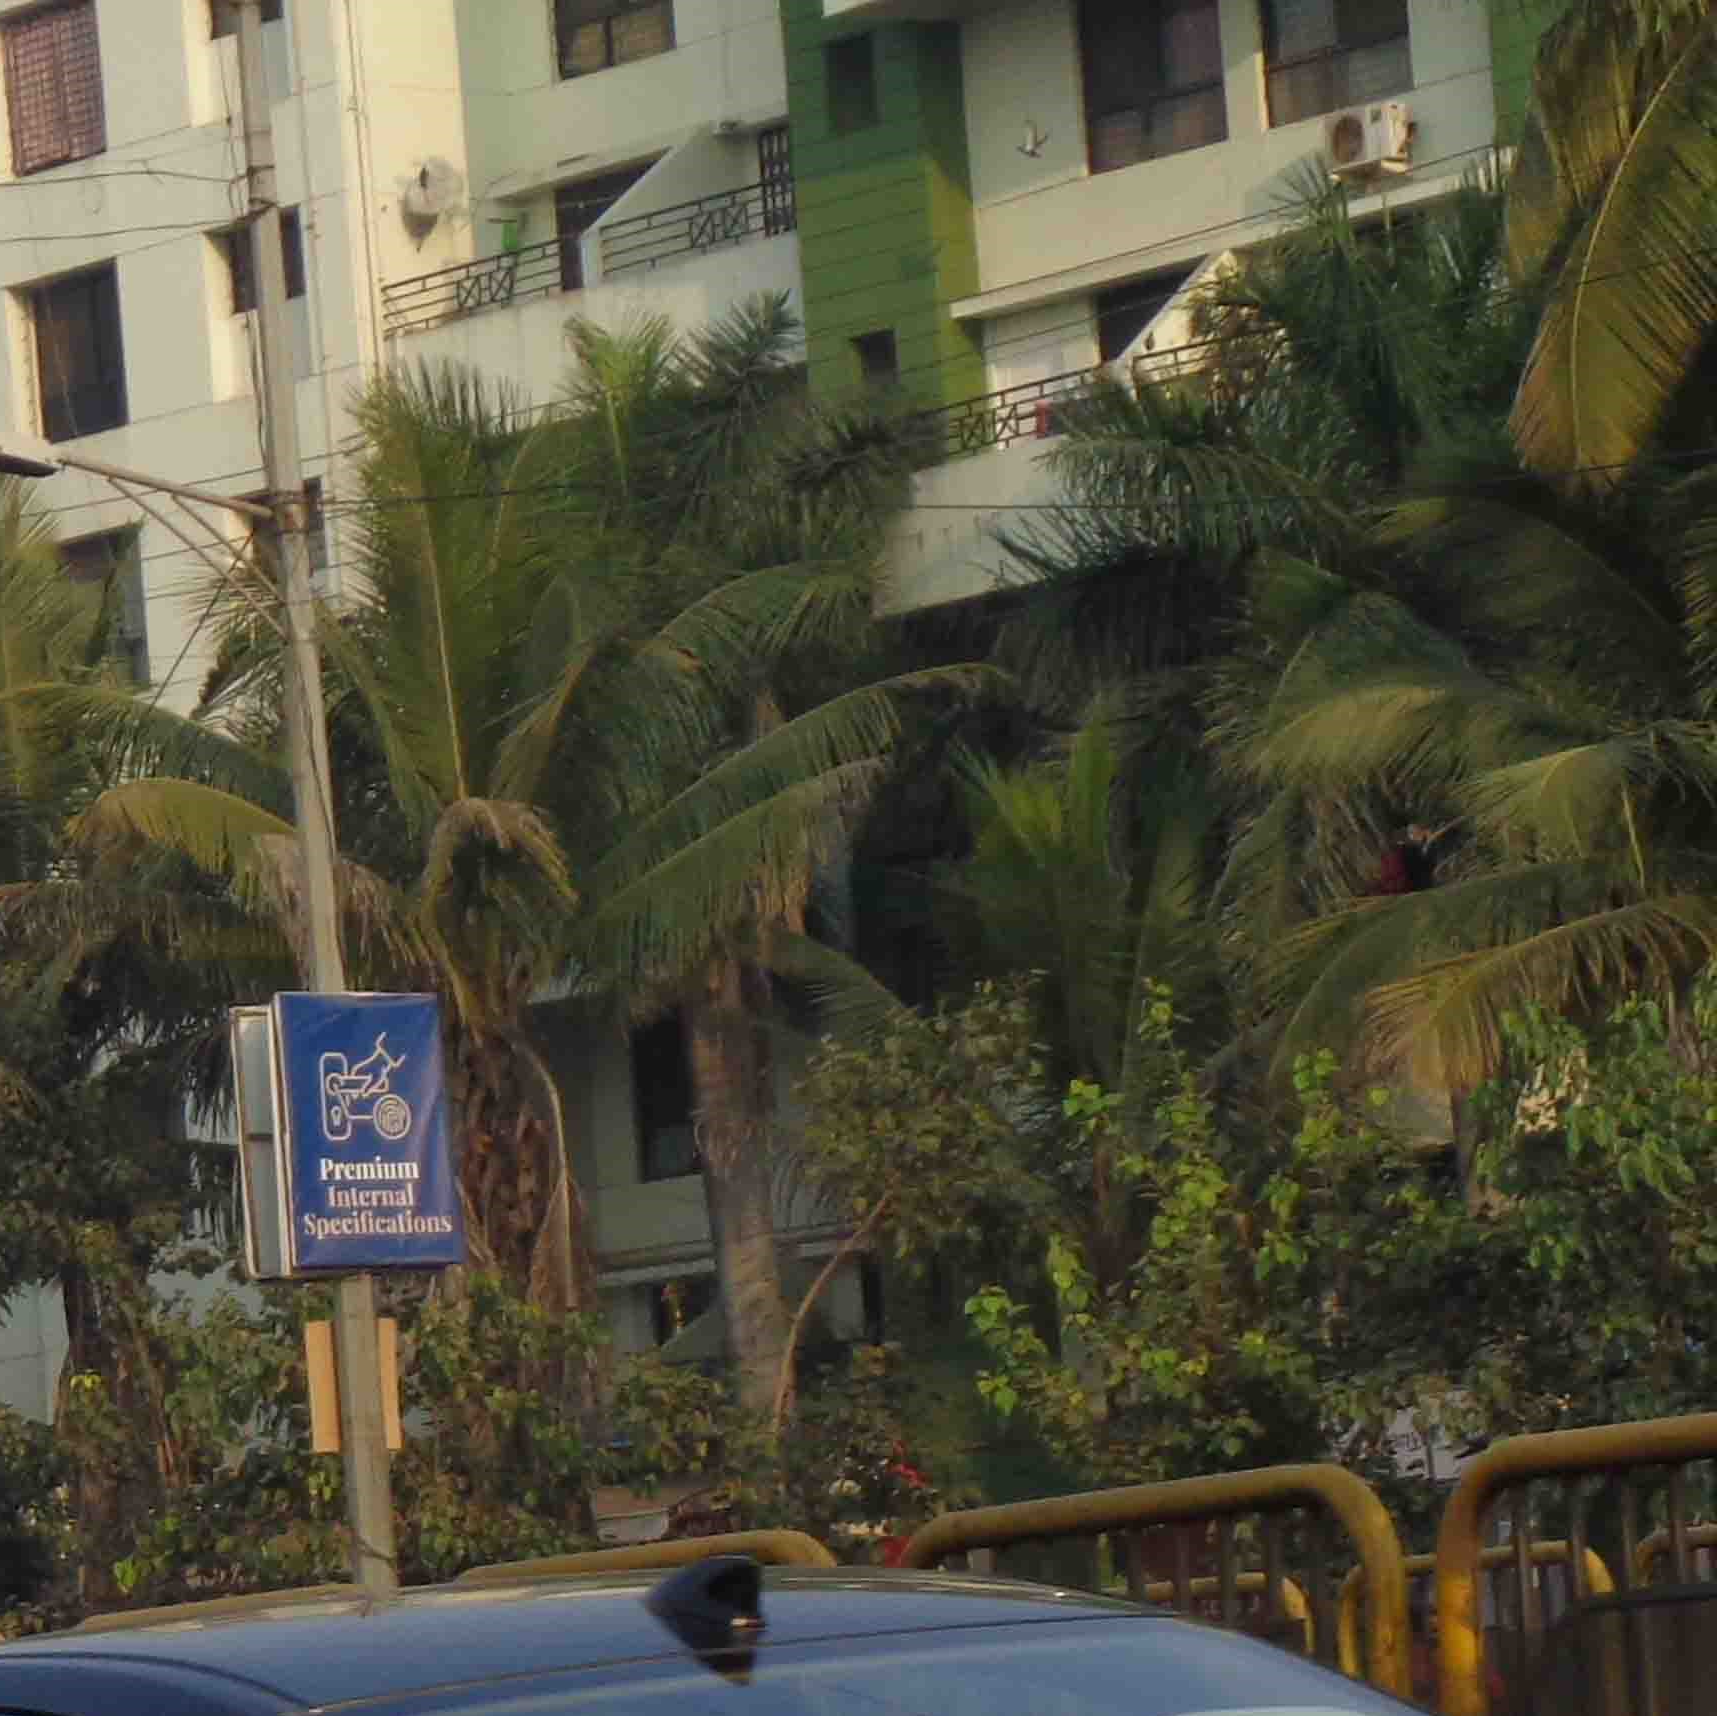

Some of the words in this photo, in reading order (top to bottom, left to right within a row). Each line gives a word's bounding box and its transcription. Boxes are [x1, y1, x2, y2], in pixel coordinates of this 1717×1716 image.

[320, 1156, 420, 1181] Premium
[328, 1184, 414, 1208] Internal
[303, 1212, 453, 1240] Specifications
